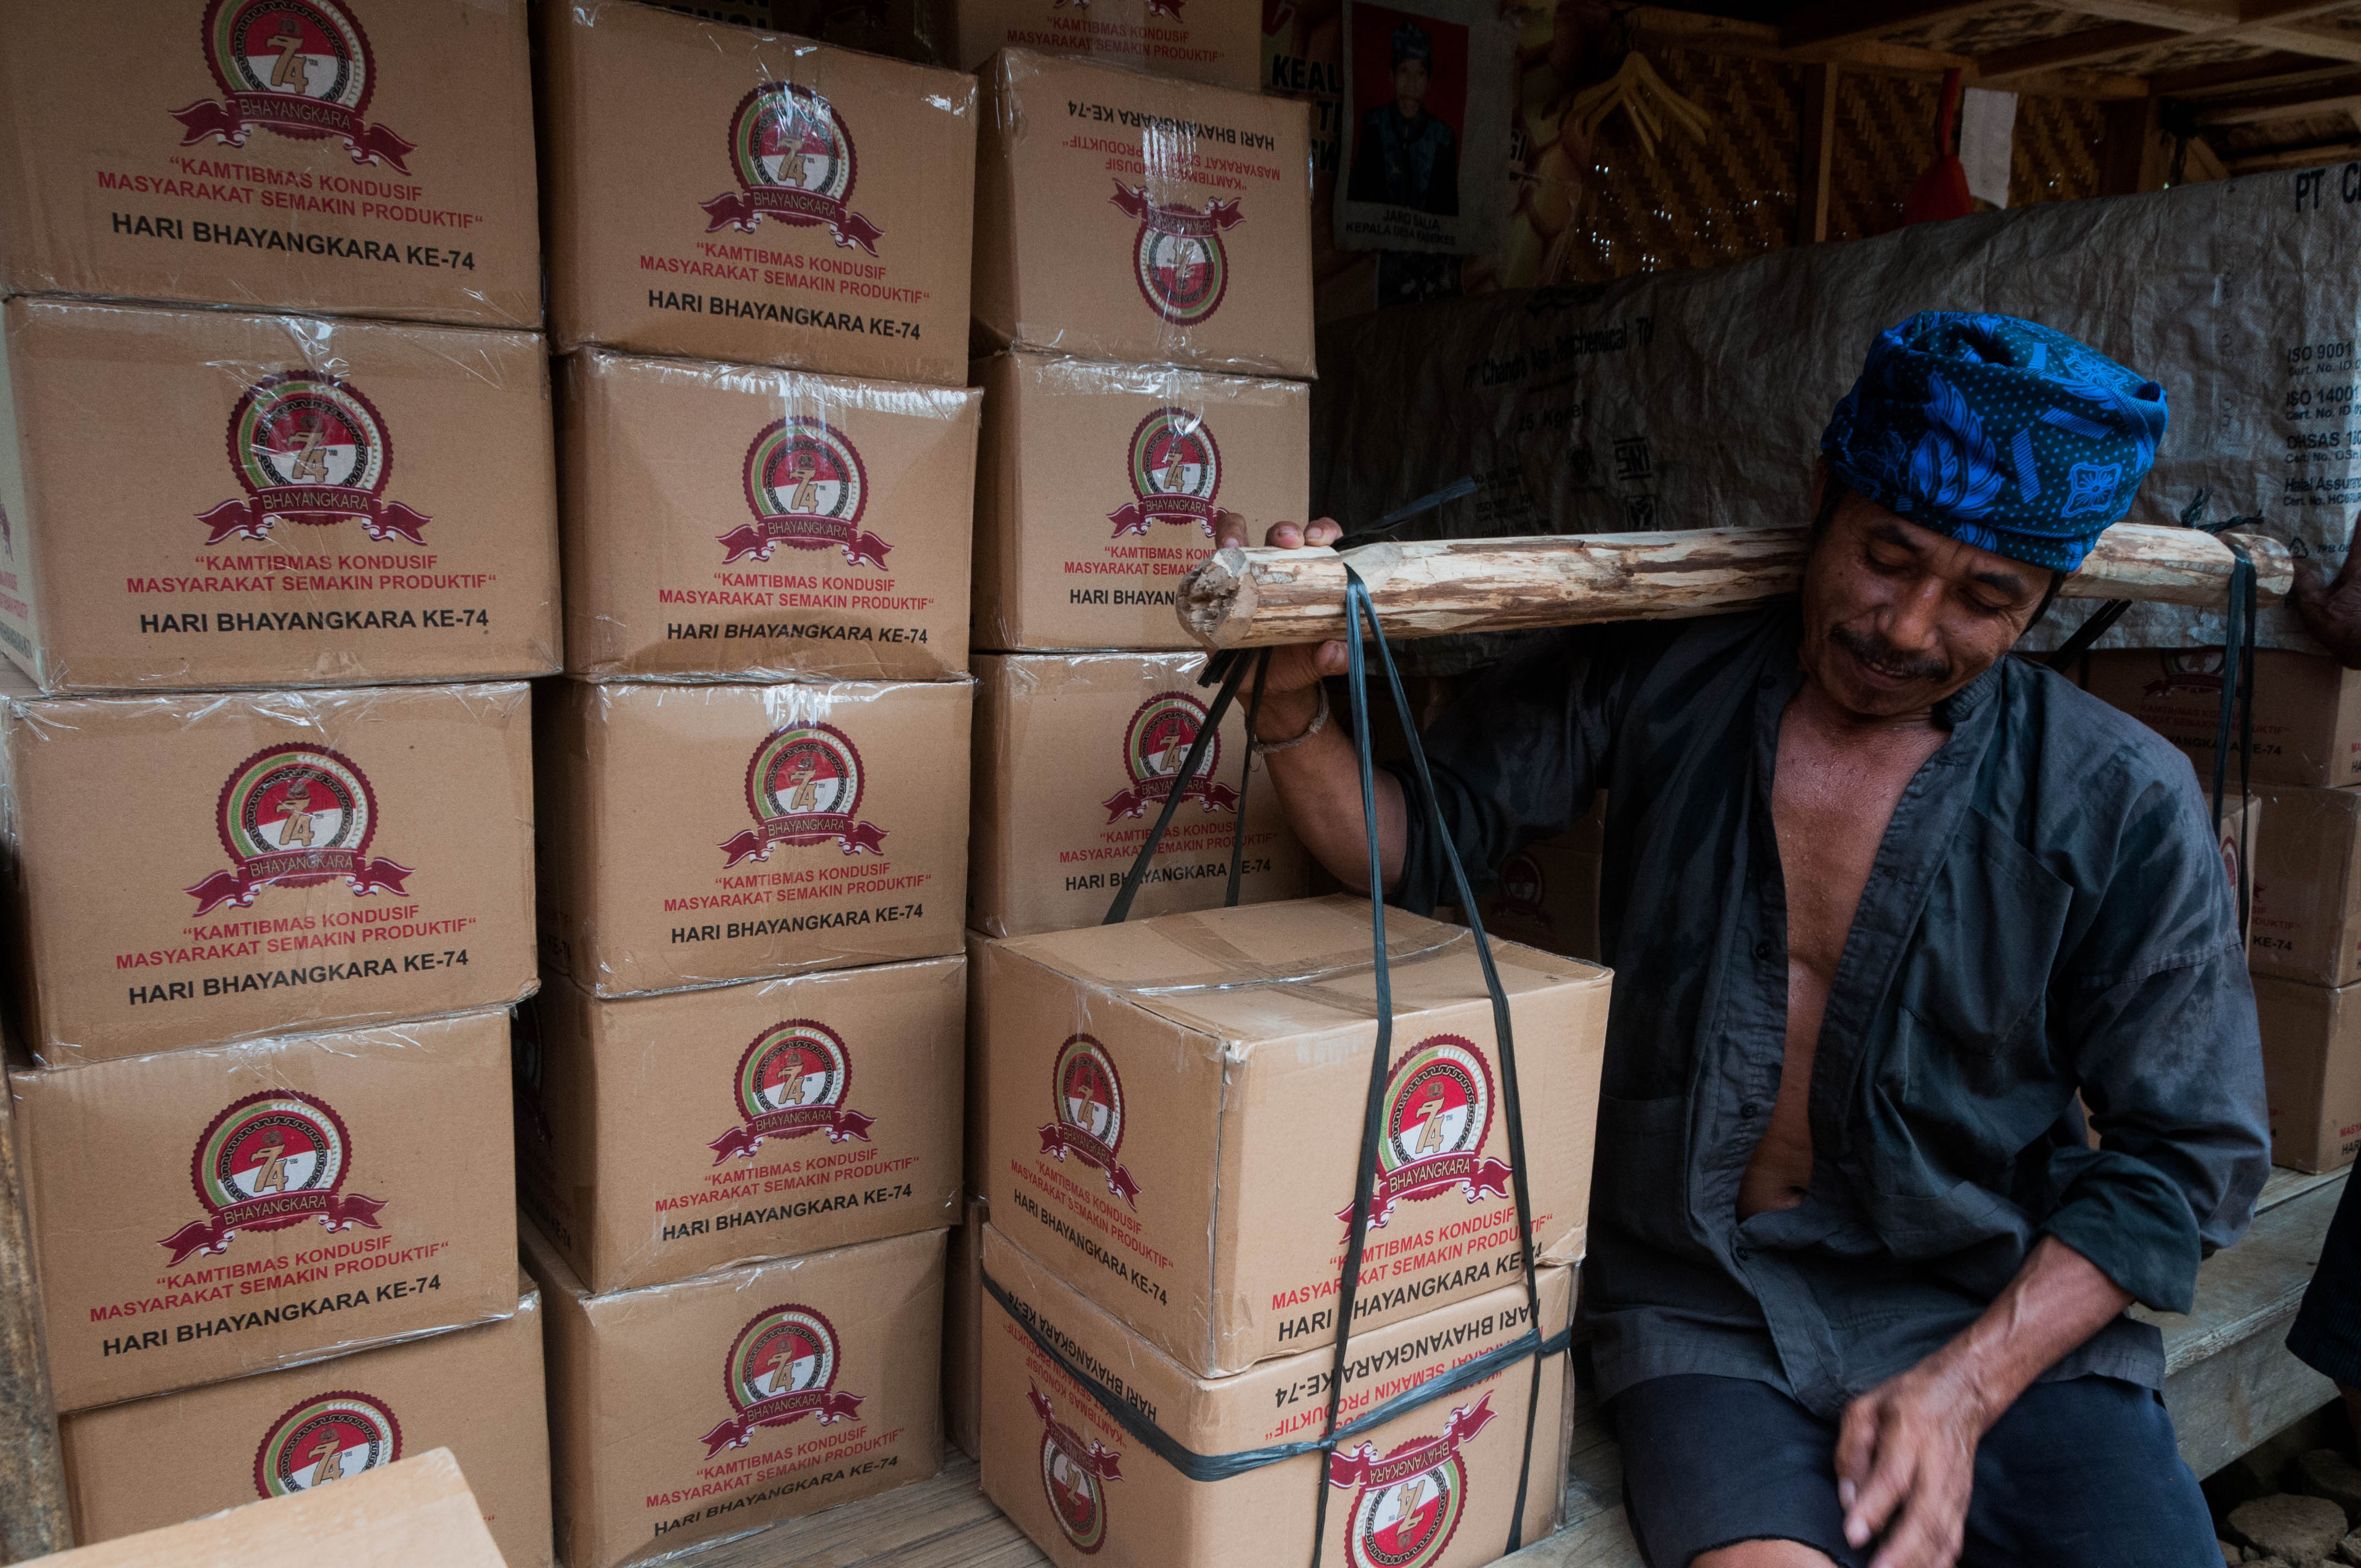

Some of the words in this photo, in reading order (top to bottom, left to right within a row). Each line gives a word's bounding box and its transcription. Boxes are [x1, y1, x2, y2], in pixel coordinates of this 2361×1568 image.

[1007, 31, 1092, 51] MASYARAKAT
[1096, 40, 1150, 57] SEMAKIN
[1130, 26, 1189, 43] KONDUSIF
[1067, 99, 1114, 121] KE-74
[1240, 130, 1274, 150] HARI
[1204, 155, 1280, 178] MASYARAKAT
[98, 172, 253, 206] MASYARAKAT
[260, 192, 356, 218] SEMAKIN
[319, 176, 423, 203] KONDUSIF
[2295, 168, 2326, 213] PT
[112, 213, 183, 240] HARI
[192, 223, 400, 264] BHAYANGKARA
[406, 247, 475, 271] KE-74
[641, 255, 757, 284] MASYARAKAT
[764, 271, 835, 294] SEMAKIN
[809, 258, 886, 281] KONDUSIF
[649, 290, 701, 313] HARI
[710, 298, 865, 333] BHAYANGKARA
[869, 319, 920, 340] KE-74
[2317, 340, 2352, 360] 9001
[338, 556, 439, 570] KONDUSIF
[1065, 563, 1148, 575] MASYARAKAT
[127, 578, 274, 594] MASYARAKAT
[281, 578, 374, 591] SEMAKIN
[660, 591, 772, 607] MASYARAKAT
[779, 595, 847, 609] SEMAKIN
[822, 578, 896, 592] KONDUSIF
[1071, 590, 1108, 604] HARI
[140, 613, 208, 633] HARI
[216, 611, 416, 632] BHAYANGKARA
[422, 609, 489, 627] KE-74
[668, 624, 719, 640] HARI
[724, 624, 873, 641] BHAYANGKARA
[880, 630, 927, 644] KE-74
[819, 863, 891, 880] KONDUSIF
[1067, 874, 1104, 891] HARI
[665, 892, 770, 913] MASYARAKAT
[777, 885, 842, 902] SEMAKIN
[322, 906, 420, 928] KONDUSIF
[672, 924, 720, 944] HARI
[727, 910, 871, 939] BHAYANGKARA
[875, 904, 923, 922] KE-74
[116, 942, 259, 970] MASYARAKAT
[266, 932, 356, 953] SEMAKIN
[129, 981, 194, 1005] HARI
[203, 958, 397, 997] BHAYANGKARA
[404, 950, 469, 972] KE-74
[806, 1148, 878, 1170] KONDUSIF
[655, 1185, 758, 1212] MASYARAKAT
[764, 1173, 830, 1194] SEMAKIN
[1390, 1160, 1470, 1194] BHAYANGKARA
[663, 1219, 709, 1241] HARI
[716, 1193, 858, 1231] BHAYANGKARA
[864, 1184, 912, 1205] KE-74
[1011, 1160, 1065, 1206] MASYARAKAT
[1068, 1198, 1108, 1235] SEMAKIN
[1093, 1196, 1141, 1238] KONDUSIF
[1439, 1206, 1515, 1243] KONDUSIF
[295, 1236, 393, 1266] KONDUSIF
[1015, 1189, 1038, 1218] HARI
[1041, 1208, 1127, 1282] BHAYANGKARA
[1131, 1269, 1166, 1308] KE-74
[1272, 1264, 1388, 1311] MASYARKAT
[1393, 1244, 1461, 1277] SEMAKIN
[91, 1285, 232, 1324] MASYARAKAT
[240, 1267, 329, 1295] SEMAKIN
[1279, 1308, 1332, 1342] HARI
[1353, 1261, 1490, 1319] HAYANGKARA
[104, 1329, 167, 1357] HARI
[177, 1289, 369, 1343] BHAYANGKARA
[376, 1275, 441, 1302] KE-74
[1039, 1314, 1123, 1397] BHAYANGKARA
[1342, 1315, 1493, 1384] BHAYANGKARA
[798, 1427, 867, 1455] KONDUSIF
[1369, 1440, 1449, 1482] BHAYANGKARA
[646, 1474, 752, 1508] MASYARAKAT
[757, 1456, 820, 1483] SEMAKIN
[654, 1511, 701, 1537] HARI
[706, 1469, 844, 1519] BHAYANGKARA
[851, 1456, 899, 1477] KE-74
